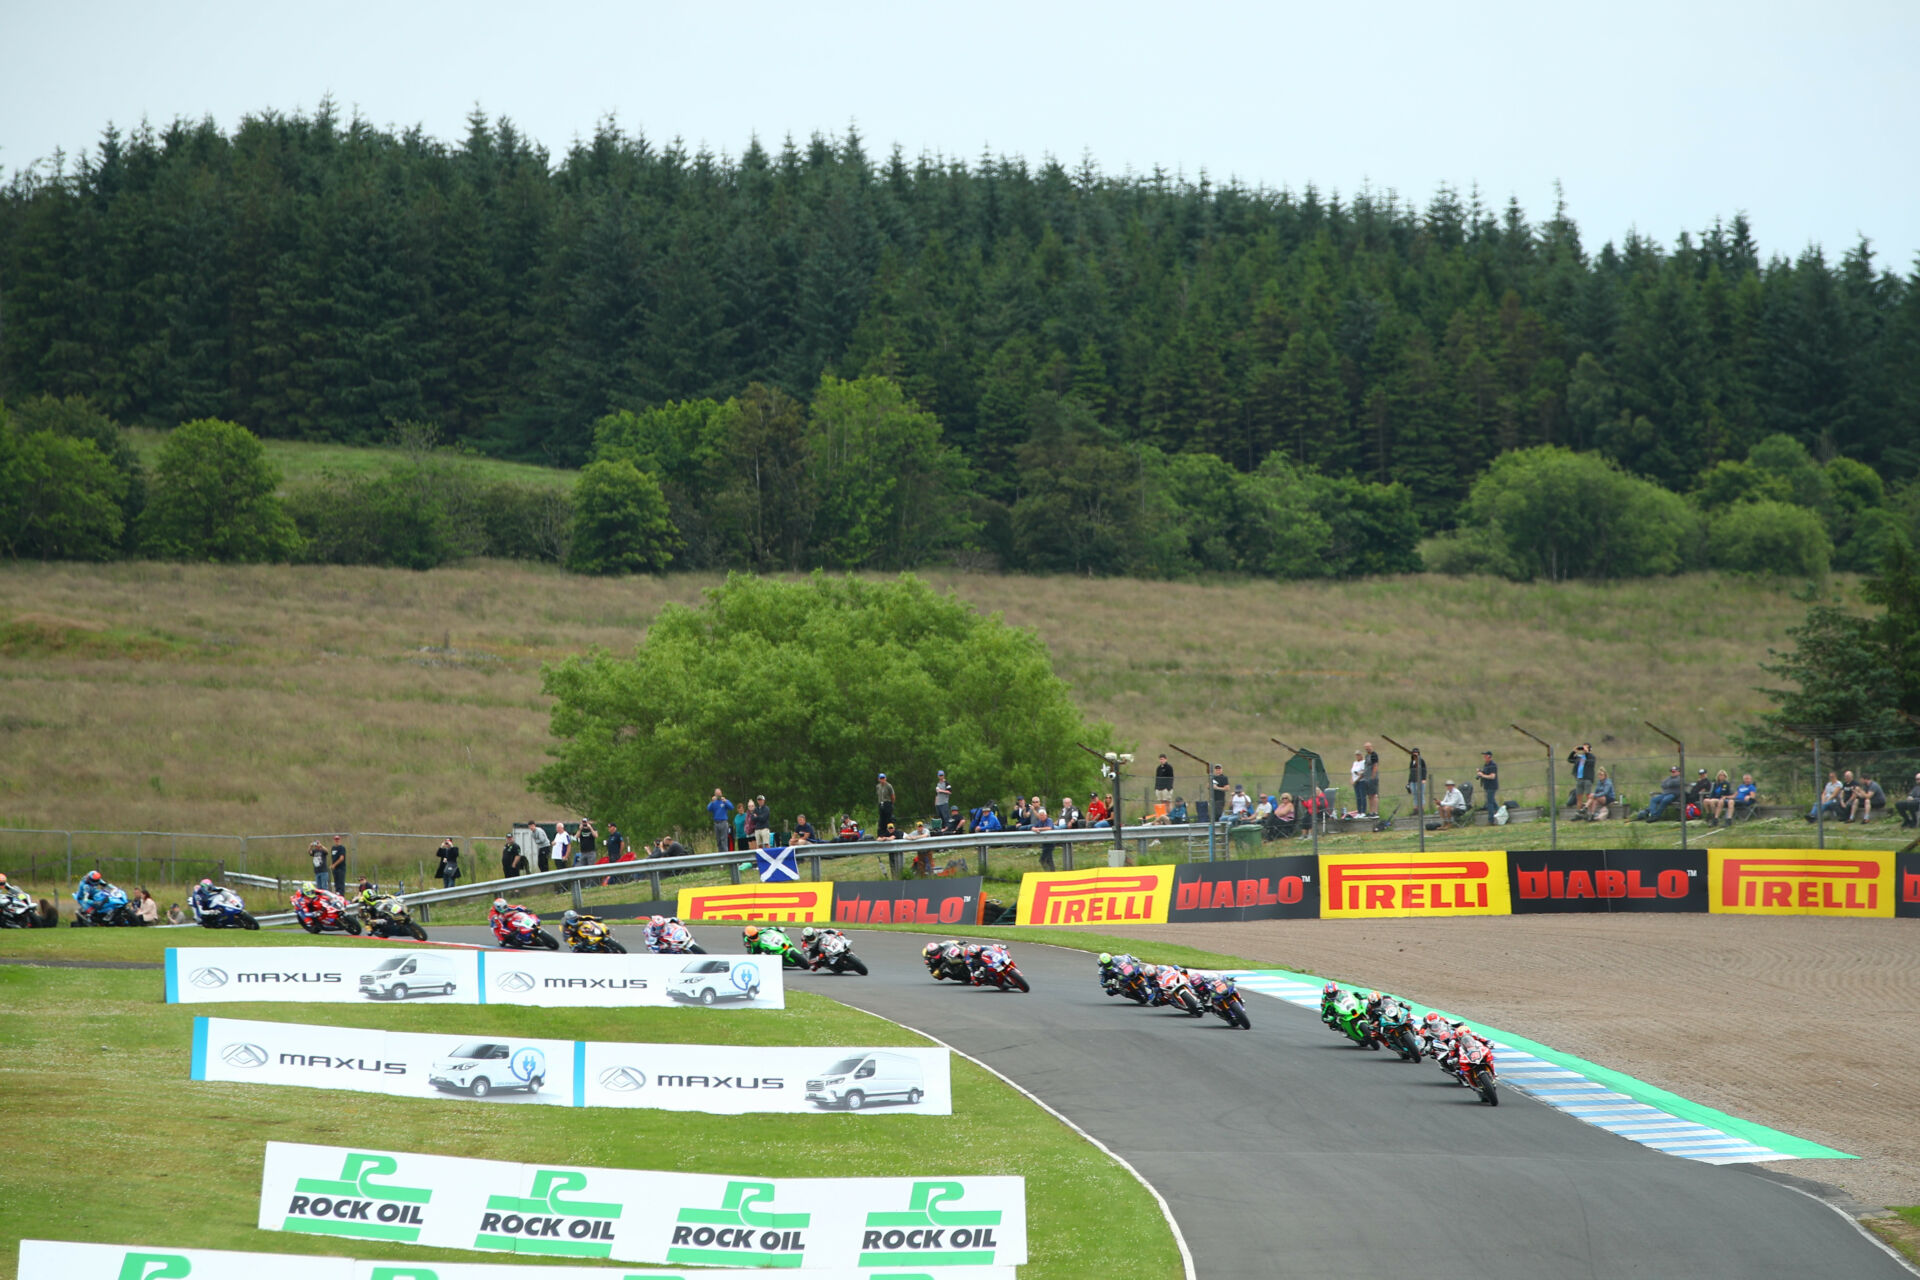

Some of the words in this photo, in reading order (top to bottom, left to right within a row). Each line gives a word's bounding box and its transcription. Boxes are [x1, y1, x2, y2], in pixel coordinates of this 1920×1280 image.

[1327, 861, 1490, 910] PIRELLI
[1721, 859, 1881, 910] PIRELLI
[1029, 875, 1159, 925] PIRELLI
[237, 972, 342, 983] MAXUS
[544, 978, 648, 989] MAXUS
[279, 1053, 407, 1075] MAXUS
[657, 1075, 784, 1089] MAXUS
[288, 1195, 373, 1220] ROCK
[376, 1203, 424, 1225] OIL
[480, 1212, 564, 1237] ROCK
[568, 1219, 615, 1240] OIL
[671, 1225, 756, 1248] ROCK
[759, 1231, 805, 1250] OIL
[862, 1229, 945, 1250] ROCK
[950, 1228, 997, 1249] OIL
